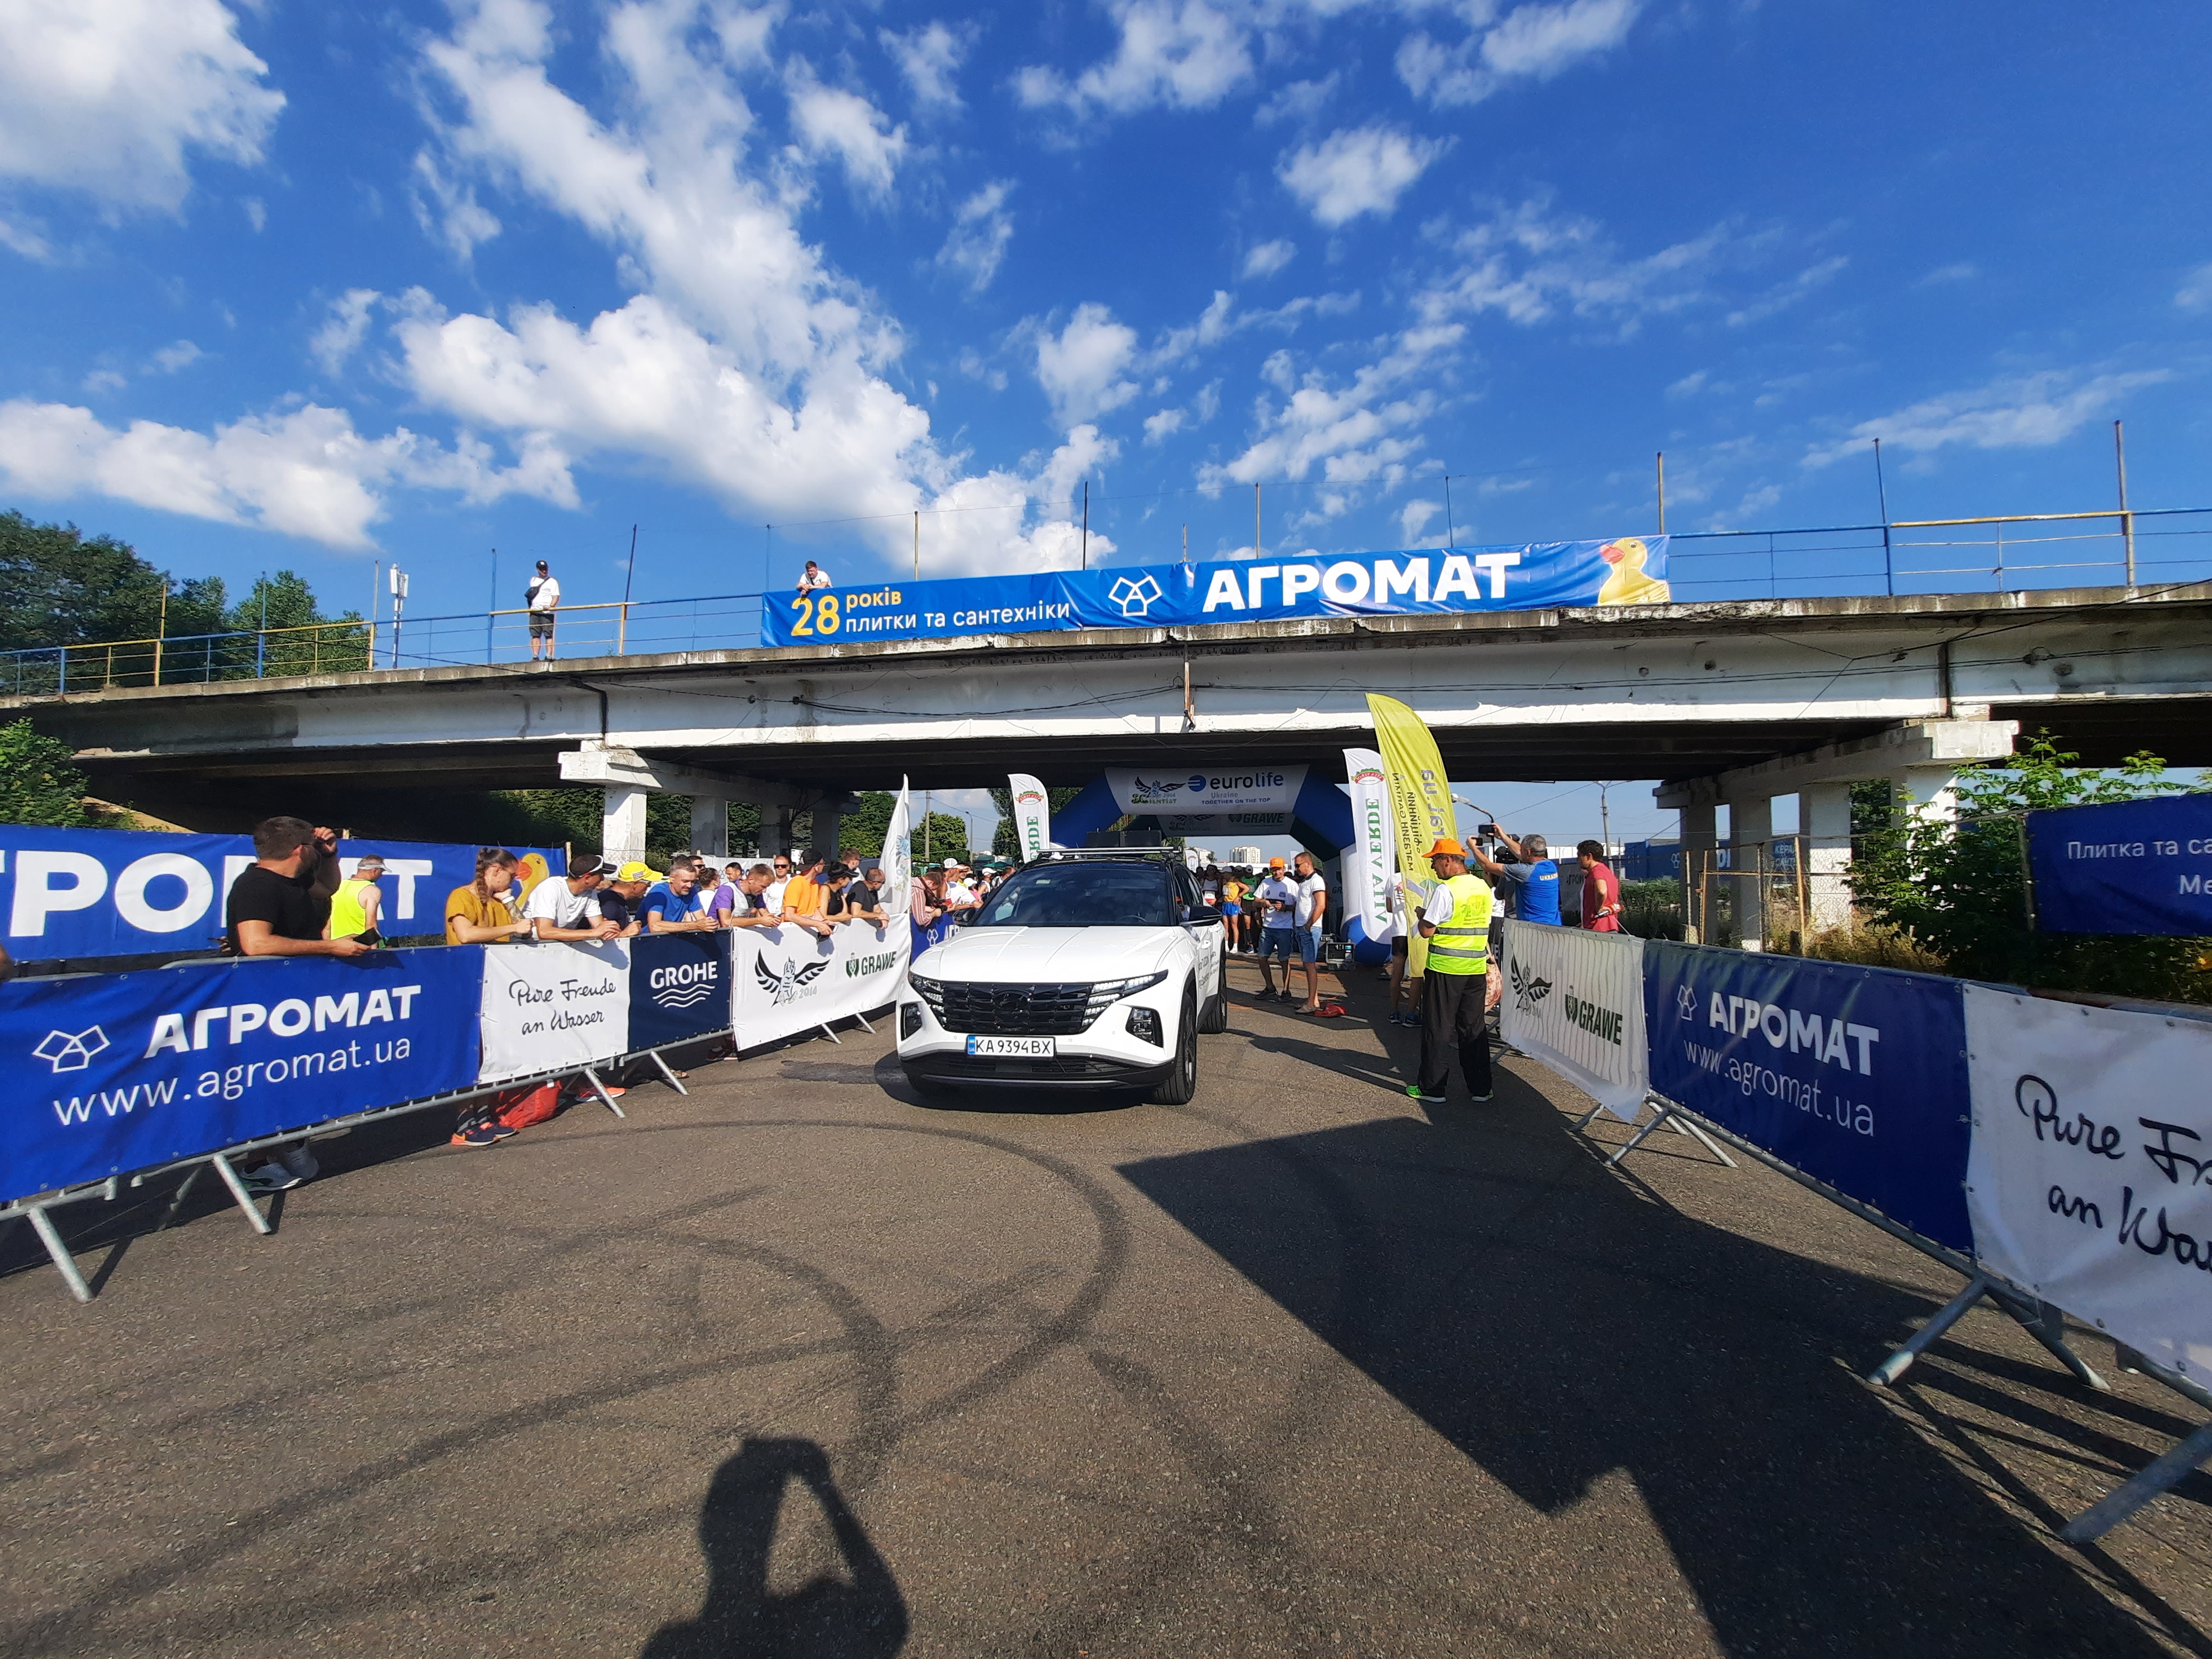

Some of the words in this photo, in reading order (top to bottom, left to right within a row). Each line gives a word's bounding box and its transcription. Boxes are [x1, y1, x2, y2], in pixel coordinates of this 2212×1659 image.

[846, 586, 902, 613] років
[1202, 551, 1521, 613] АГРОМАТ
[791, 594, 840, 637] 28
[846, 614, 916, 633] плитки
[924, 612, 946, 628] та
[953, 599, 1070, 627] сантехніки
[1209, 772, 1284, 790] eurolife
[1242, 813, 1284, 823] GRAWE
[2067, 841, 2145, 860] Плитка
[2152, 839, 2179, 855] та
[650, 961, 718, 989] GROHE
[860, 951, 898, 977] GRAWE
[509, 979, 554, 1006] Pure
[560, 977, 617, 1001] Freude
[143, 985, 422, 1060] АГРОМАТ
[521, 1021, 544, 1035] an
[550, 1009, 605, 1031] Wasser
[1578, 1000, 1623, 1046] GRAWE
[1708, 992, 1880, 1077] АГРОМАТ
[53, 1037, 412, 1126] www.agromat.ua
[1683, 1039, 1875, 1138] www.agromat.ua
[2015, 1074, 2126, 1160] Pure
[2047, 1185, 2103, 1229] an
